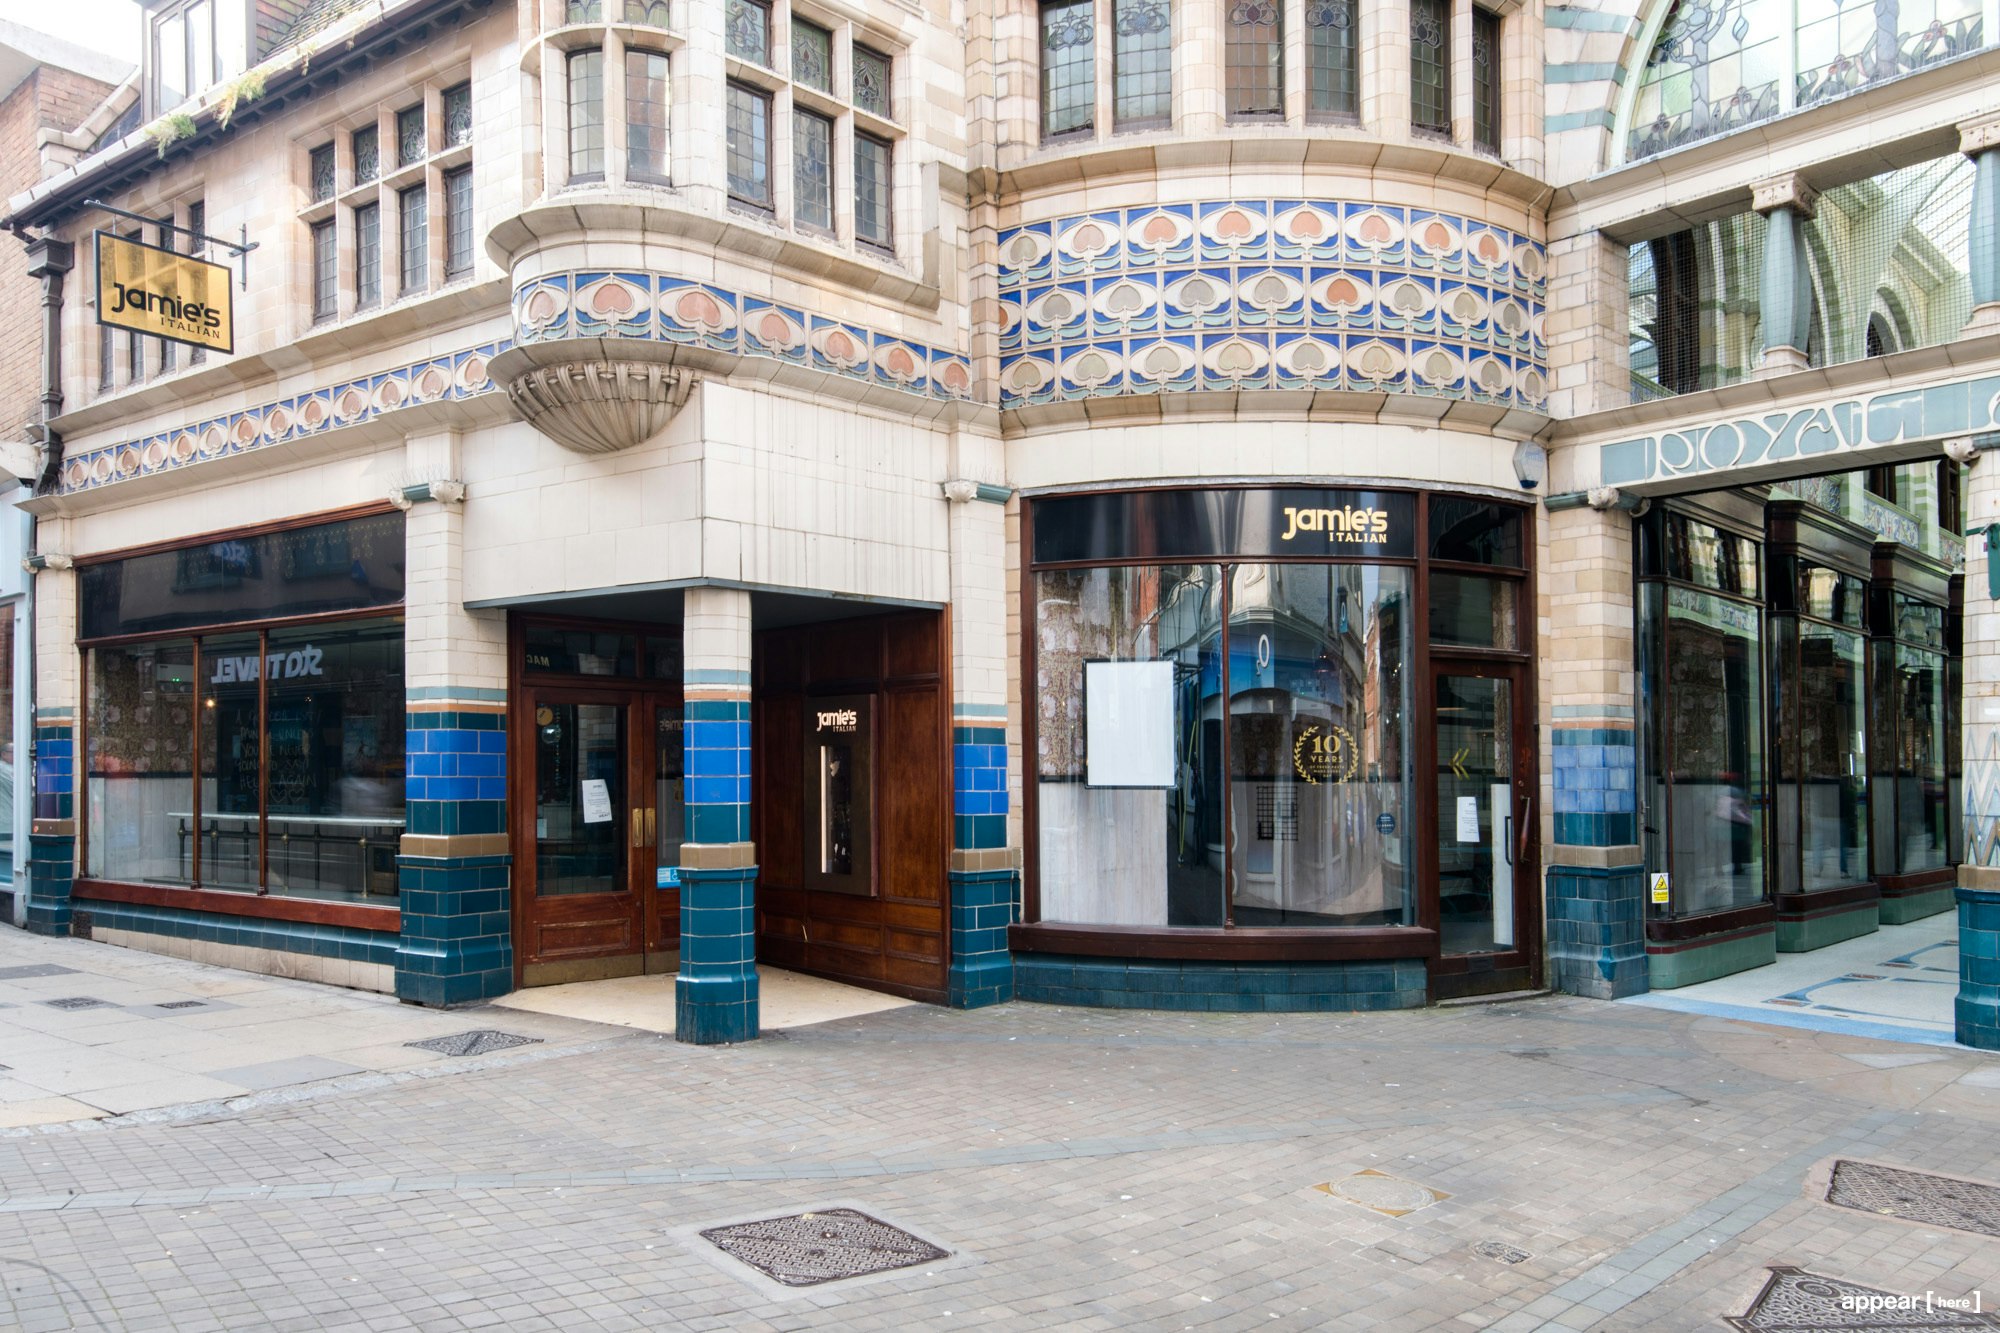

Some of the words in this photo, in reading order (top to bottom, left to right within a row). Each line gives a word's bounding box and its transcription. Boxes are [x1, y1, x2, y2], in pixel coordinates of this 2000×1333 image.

[111, 281, 220, 328] Jamie's
[161, 316, 220, 339] ITALIAN
[1650, 394, 1904, 479] ROYAL
[1281, 504, 1388, 540] Jamie's
[1329, 531, 1387, 544] ITALIAN
[816, 708, 857, 732] Jamie's
[832, 725, 857, 733] ITALIAN
[1312, 735, 1341, 753] 10
[1311, 755, 1344, 763] YEARS
